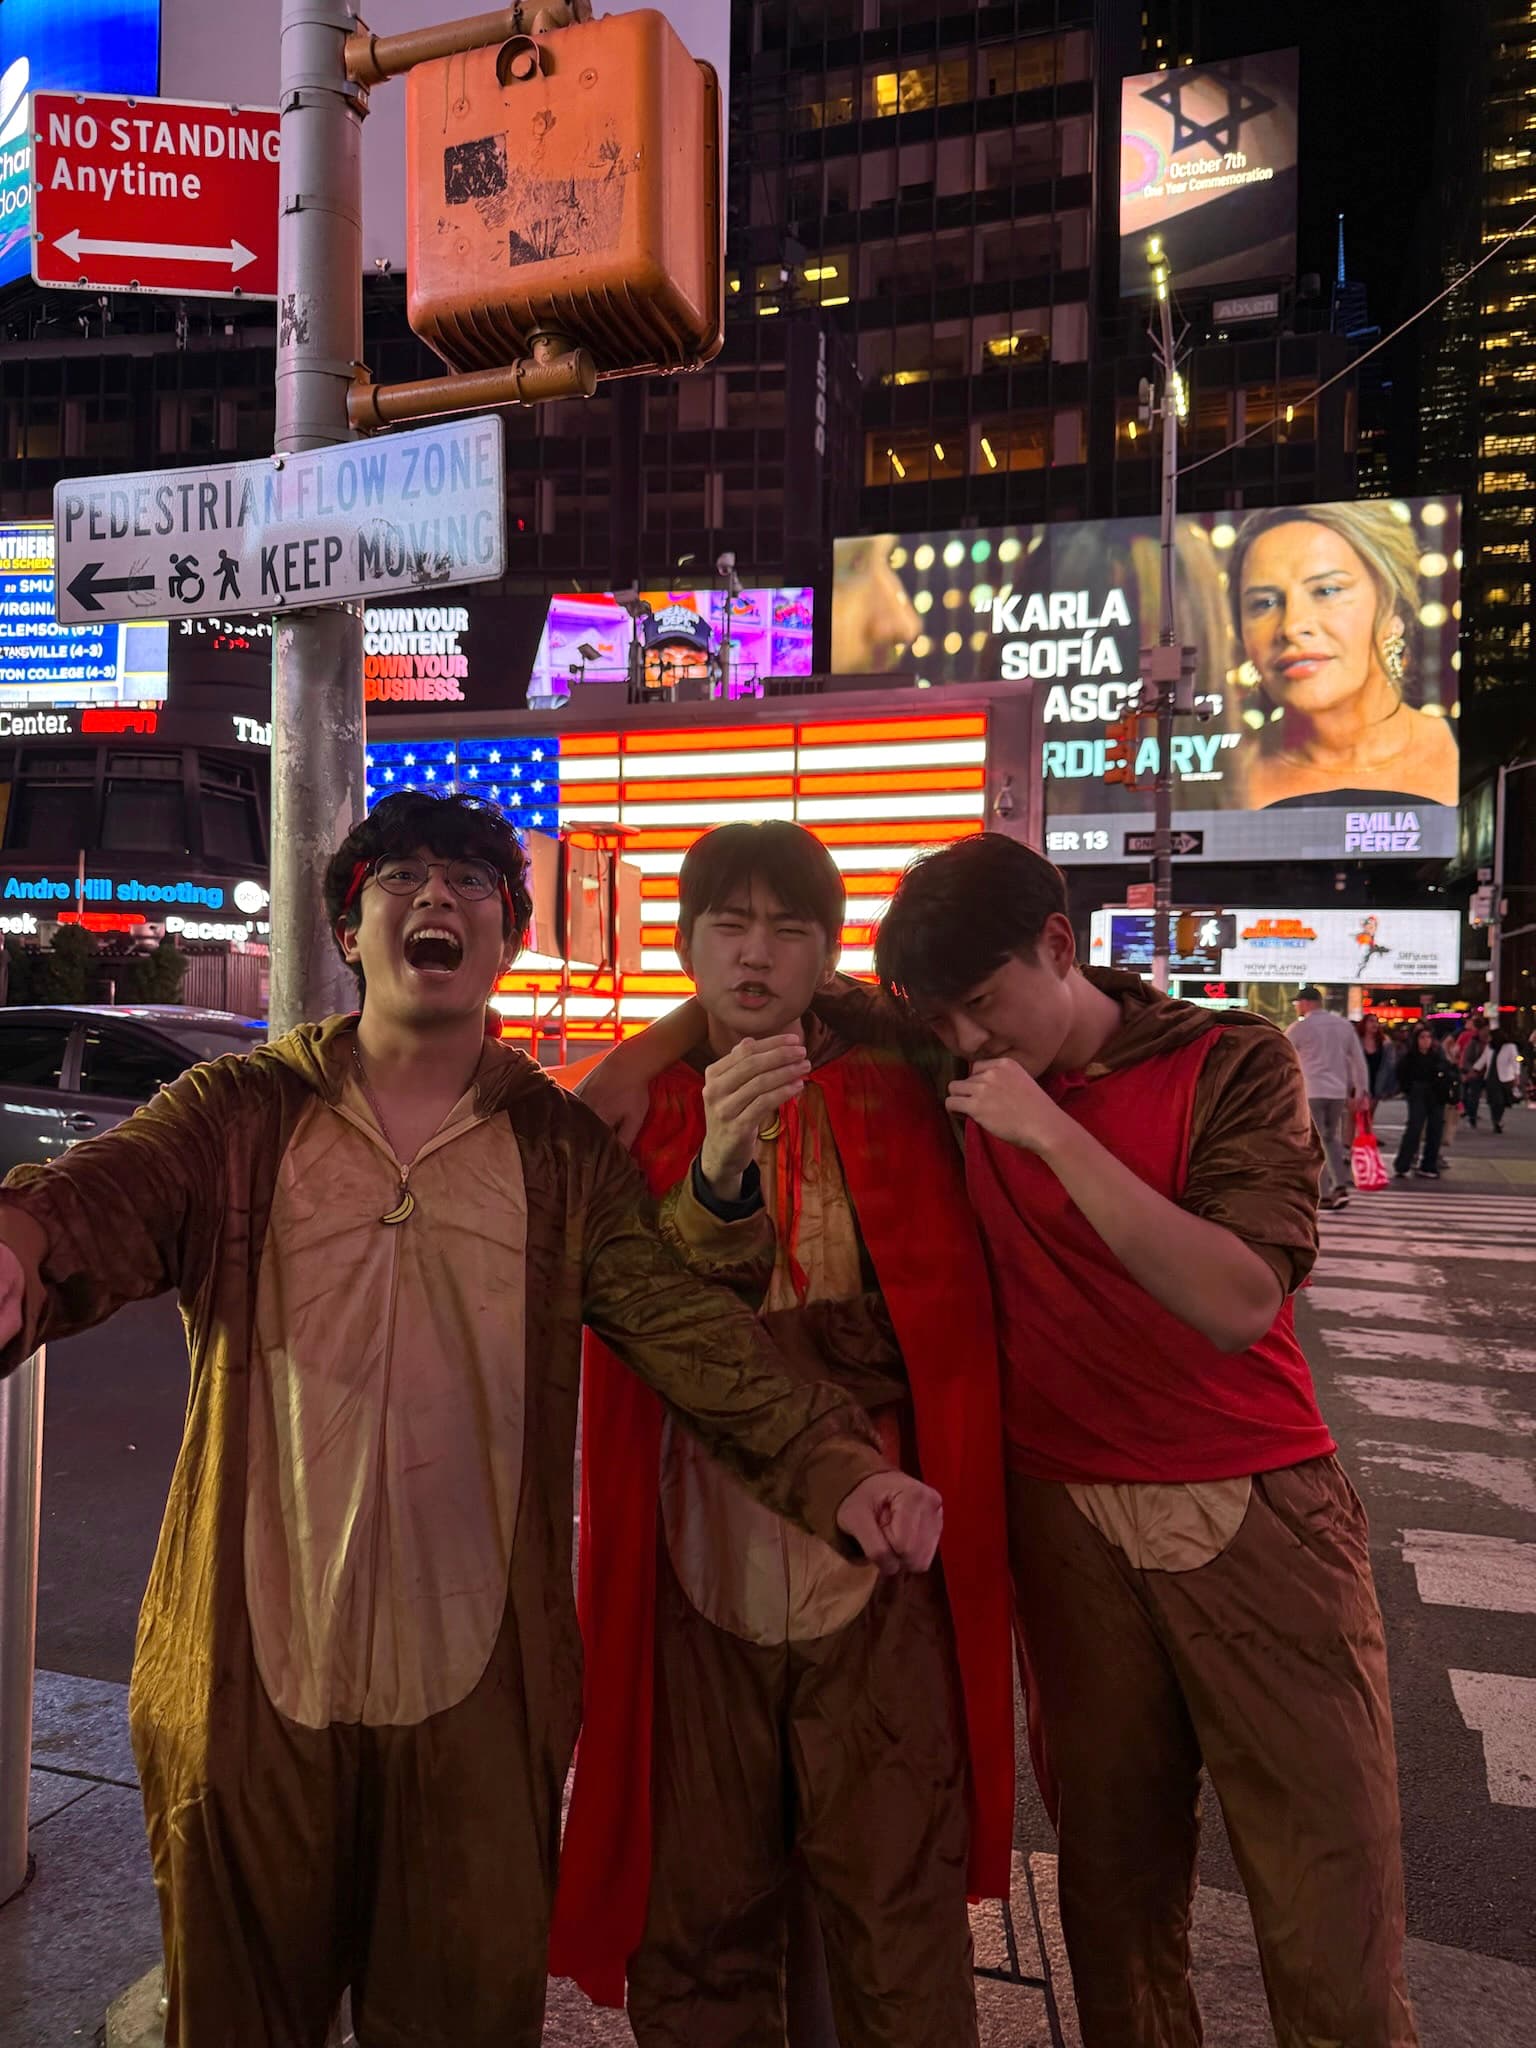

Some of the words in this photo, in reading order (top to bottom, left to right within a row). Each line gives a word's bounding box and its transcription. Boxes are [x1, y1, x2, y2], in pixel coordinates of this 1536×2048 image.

[49, 113, 97, 149] NO
[110, 118, 280, 163] STANDING
[1169, 157, 1223, 179] October
[1223, 151, 1247, 171] 7th
[51, 157, 201, 201] Anytime
[65, 472, 283, 543] PEDESTRIAN
[297, 453, 387, 519] FLOW
[401, 432, 494, 500] ZONE
[261, 535, 343, 596] KEEP
[358, 510, 494, 582] MOVING
[19, 579, 54, 593] SMU
[0, 623, 69, 638] CLEMSON
[364, 608, 414, 633] OWN
[414, 607, 469, 632] YOUR
[69, 643, 103, 659] (4-3)
[363, 631, 462, 655] CONTENT.
[1000, 629, 1123, 680] SOFÍA
[27, 666, 85, 681] COLLEGE
[85, 664, 116, 679] (4-3)
[364, 655, 413, 678] OWN
[413, 654, 469, 678] YOUR
[364, 678, 465, 701] BUSINESS.
[0, 711, 73, 736] Center.
[1345, 811, 1420, 833] EMILIA
[1082, 830, 1109, 851] 13
[4, 877, 70, 899] Andre
[75, 878, 112, 899] Hill
[117, 880, 224, 909] shooting
[165, 915, 254, 942] Pacers'
